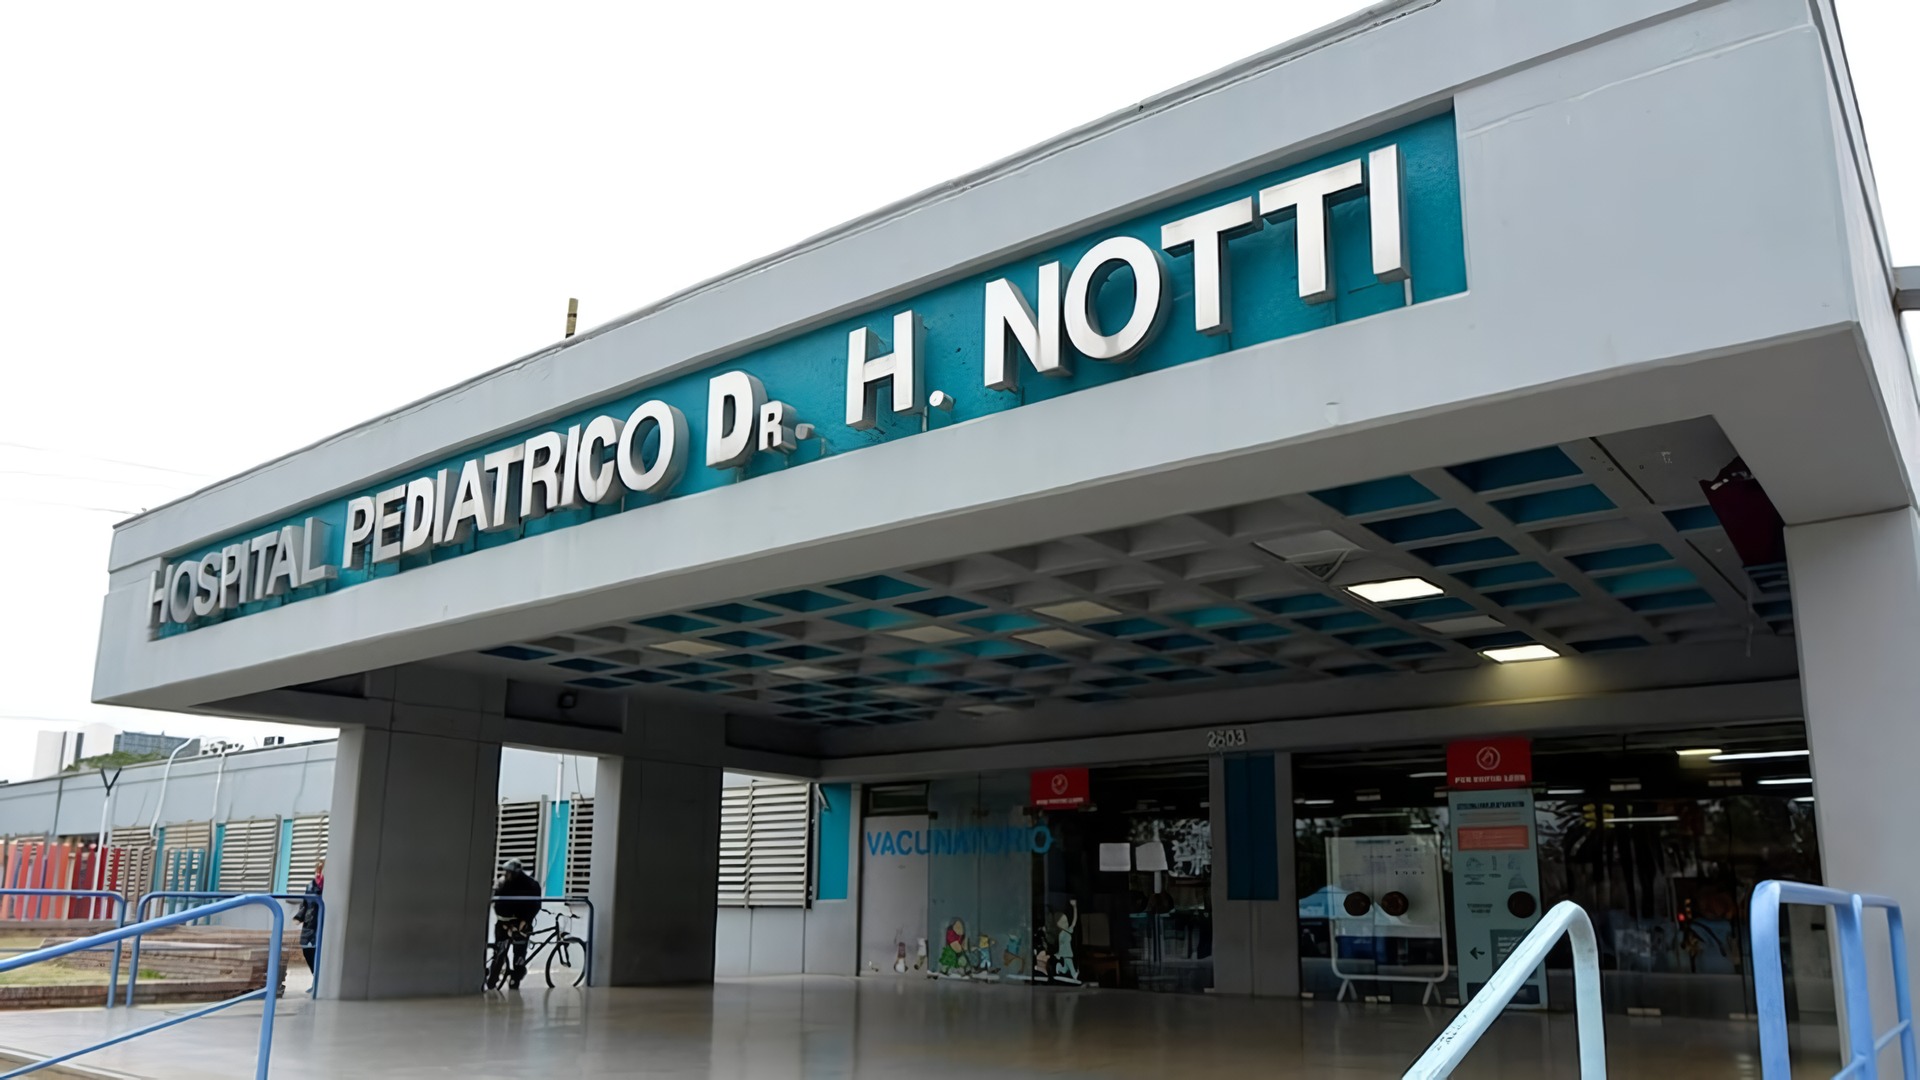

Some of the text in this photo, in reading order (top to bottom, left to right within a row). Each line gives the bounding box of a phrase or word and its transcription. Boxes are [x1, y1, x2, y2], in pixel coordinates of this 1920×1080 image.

[147, 517, 335, 634] HOSPITAL
[342, 399, 684, 571] PEDIATRICO
[846, 309, 952, 430] H.
[984, 143, 1407, 392] NOTTI
[866, 823, 1053, 856] VACUNATORIO
